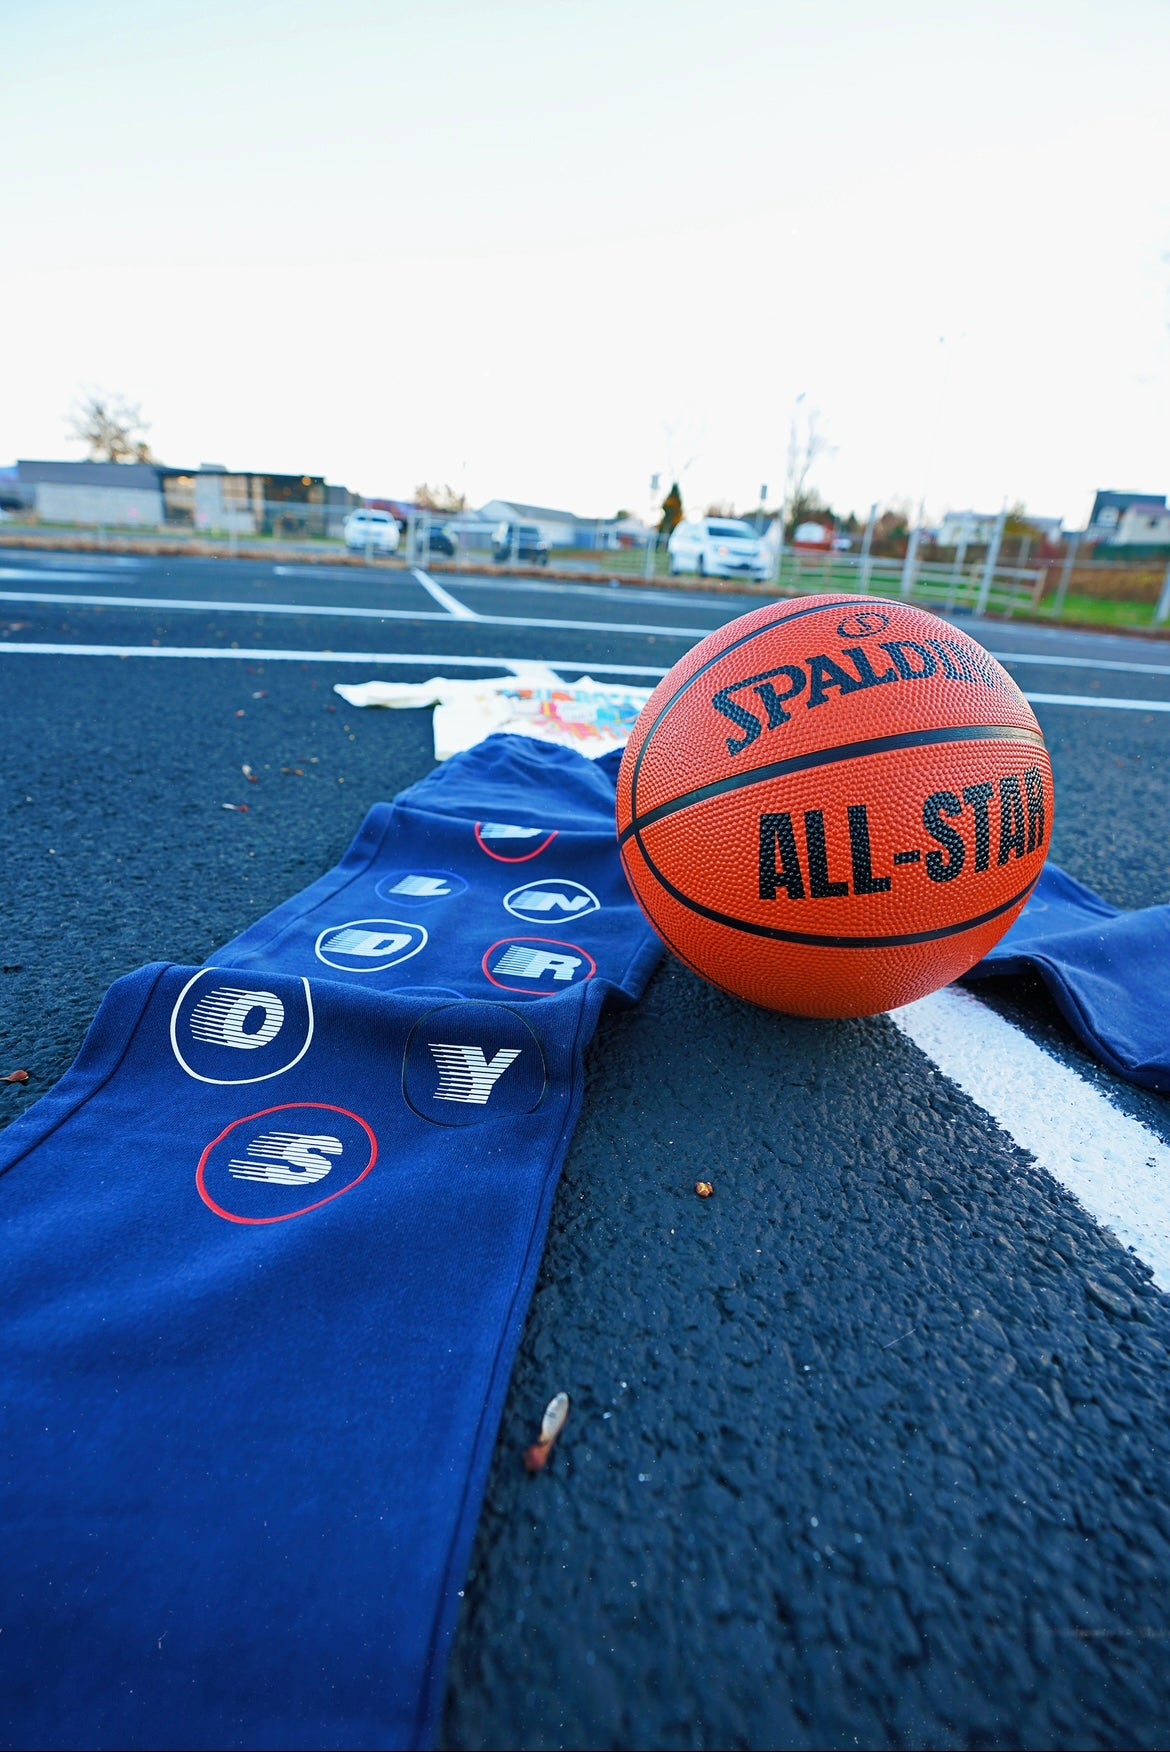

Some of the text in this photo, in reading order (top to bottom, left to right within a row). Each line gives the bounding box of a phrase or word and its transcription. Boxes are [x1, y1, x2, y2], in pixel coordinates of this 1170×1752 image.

[759, 767, 1044, 900] ALL-STAR
[510, 891, 591, 911] N
[321, 928, 412, 957] D
[492, 945, 582, 980] R
[190, 987, 284, 1049] O
[428, 1043, 522, 1104] Y
[228, 1131, 343, 1185] S
